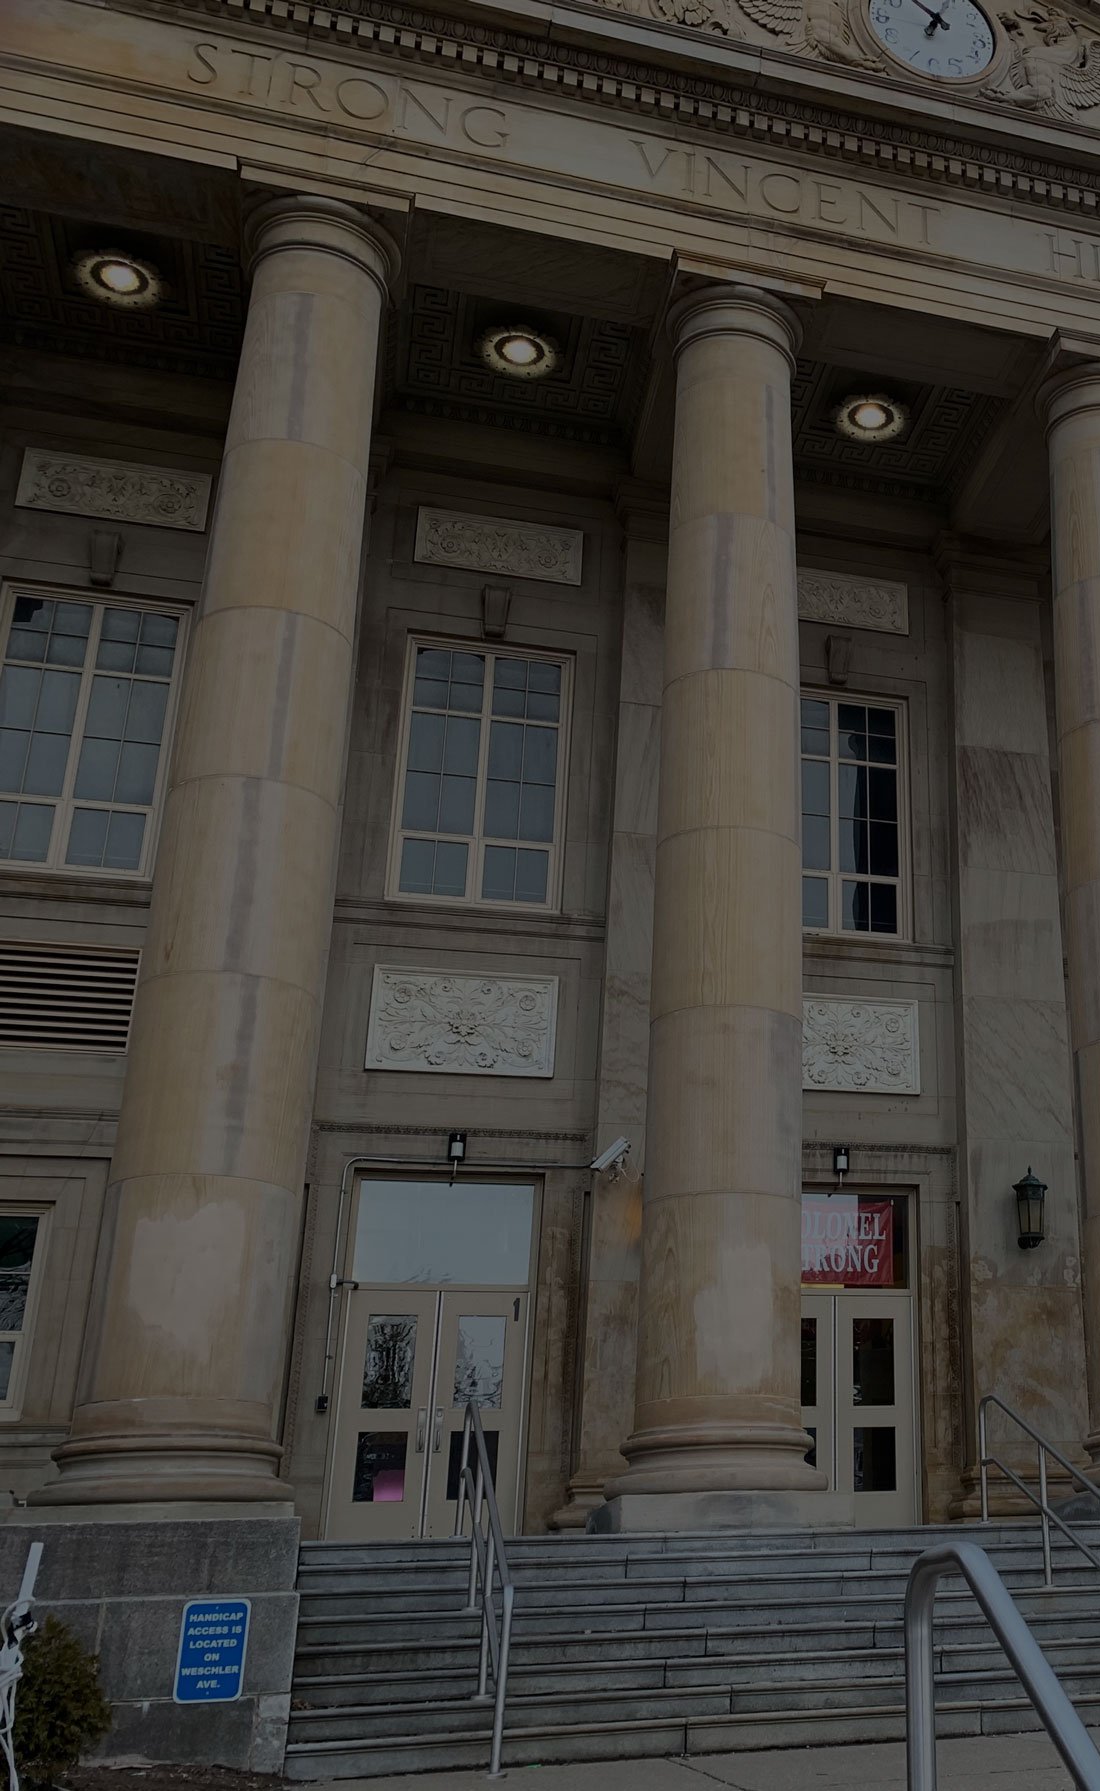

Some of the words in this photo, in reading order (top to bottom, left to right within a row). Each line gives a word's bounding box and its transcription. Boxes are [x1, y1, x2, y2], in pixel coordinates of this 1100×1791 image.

[187, 43, 510, 148] STRONG
[628, 139, 941, 245] VINCENT
[189, 1612, 244, 1622] HANDICAP
[187, 1626, 229, 1636] ACCESS
[231, 1625, 242, 1634] IS
[189, 1639, 238, 1649] LOCATED
[203, 1652, 220, 1661] ON
[181, 1665, 240, 1676] WESCHLER
[195, 1679, 221, 1689] AVE.
